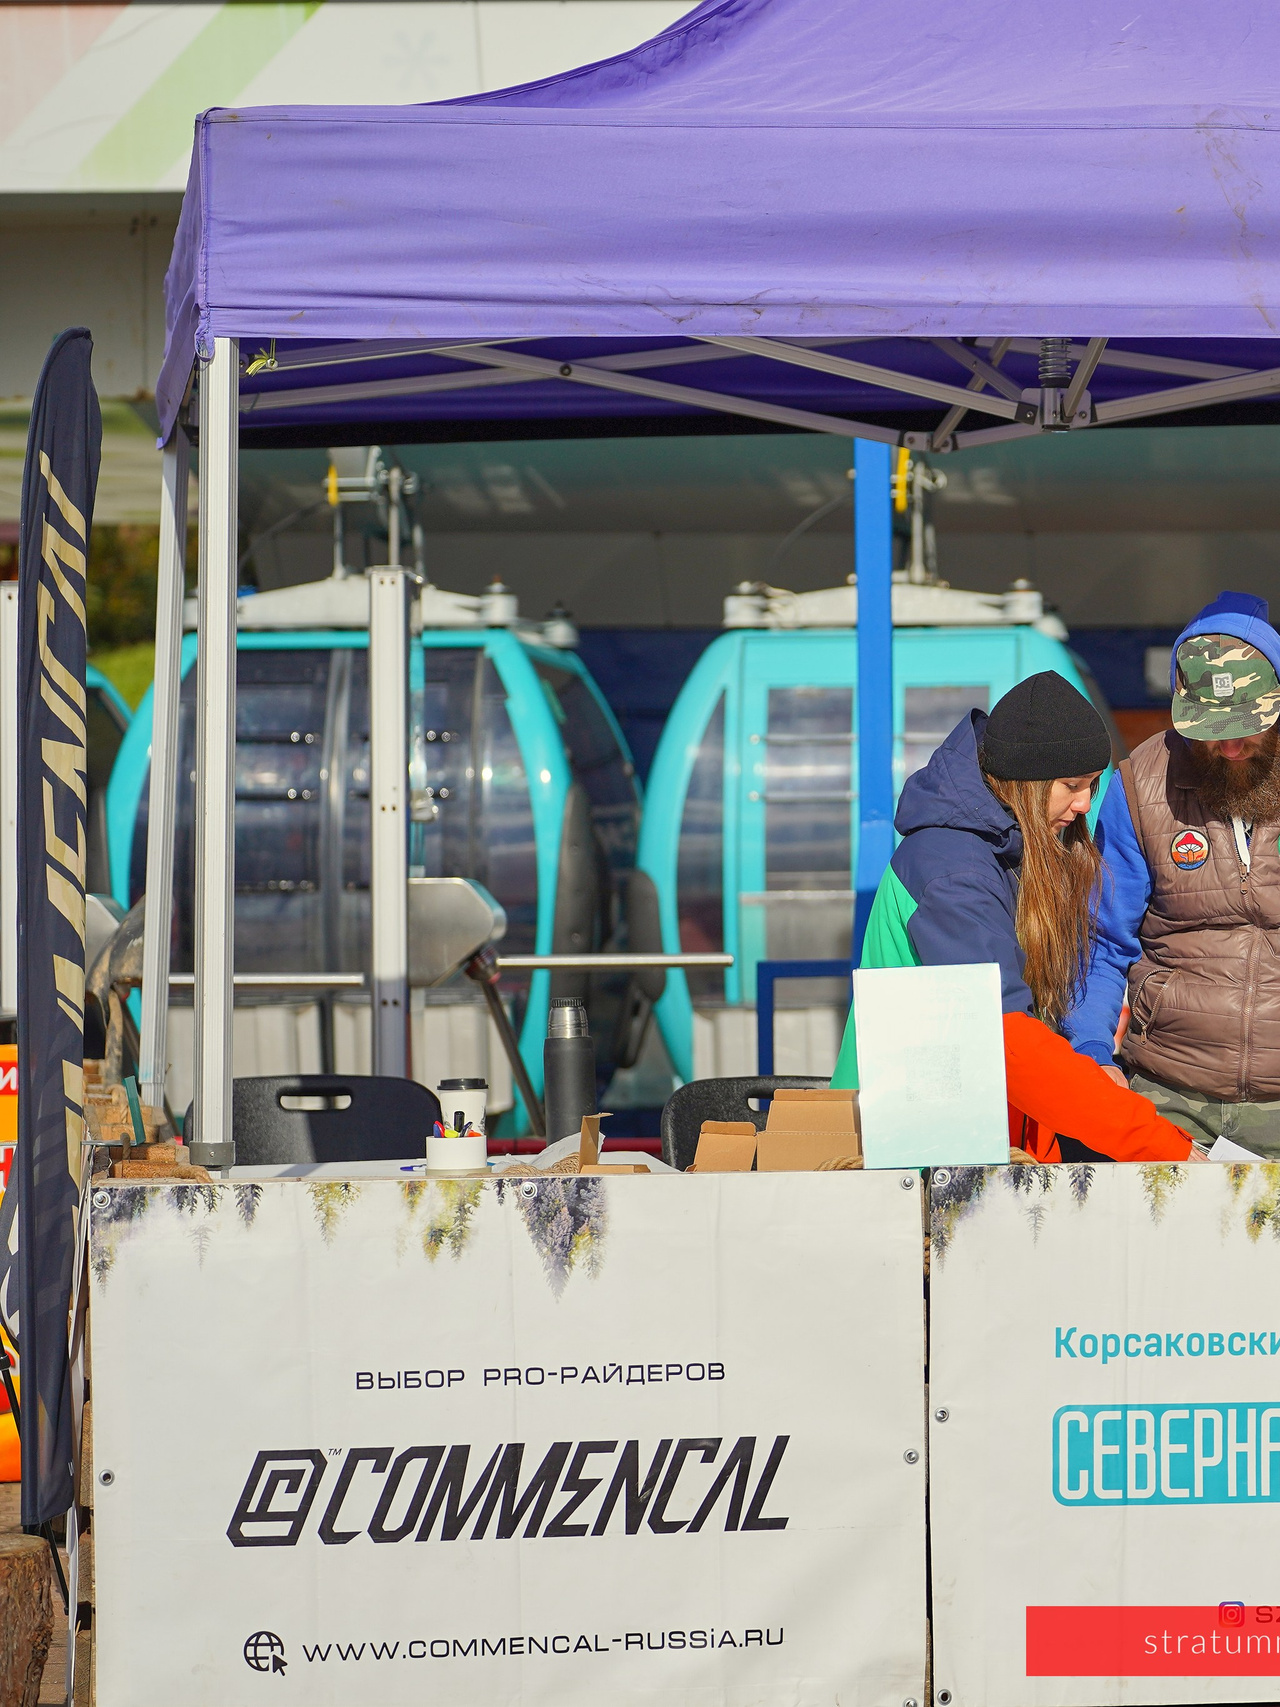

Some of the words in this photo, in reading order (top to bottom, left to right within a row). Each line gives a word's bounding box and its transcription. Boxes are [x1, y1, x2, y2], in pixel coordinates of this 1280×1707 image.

[355, 1369, 465, 1390] ВЫБОР
[483, 1362, 725, 1387] PRO-РАЙДЕРОВ
[317, 1435, 790, 1545] COMMENCAL
